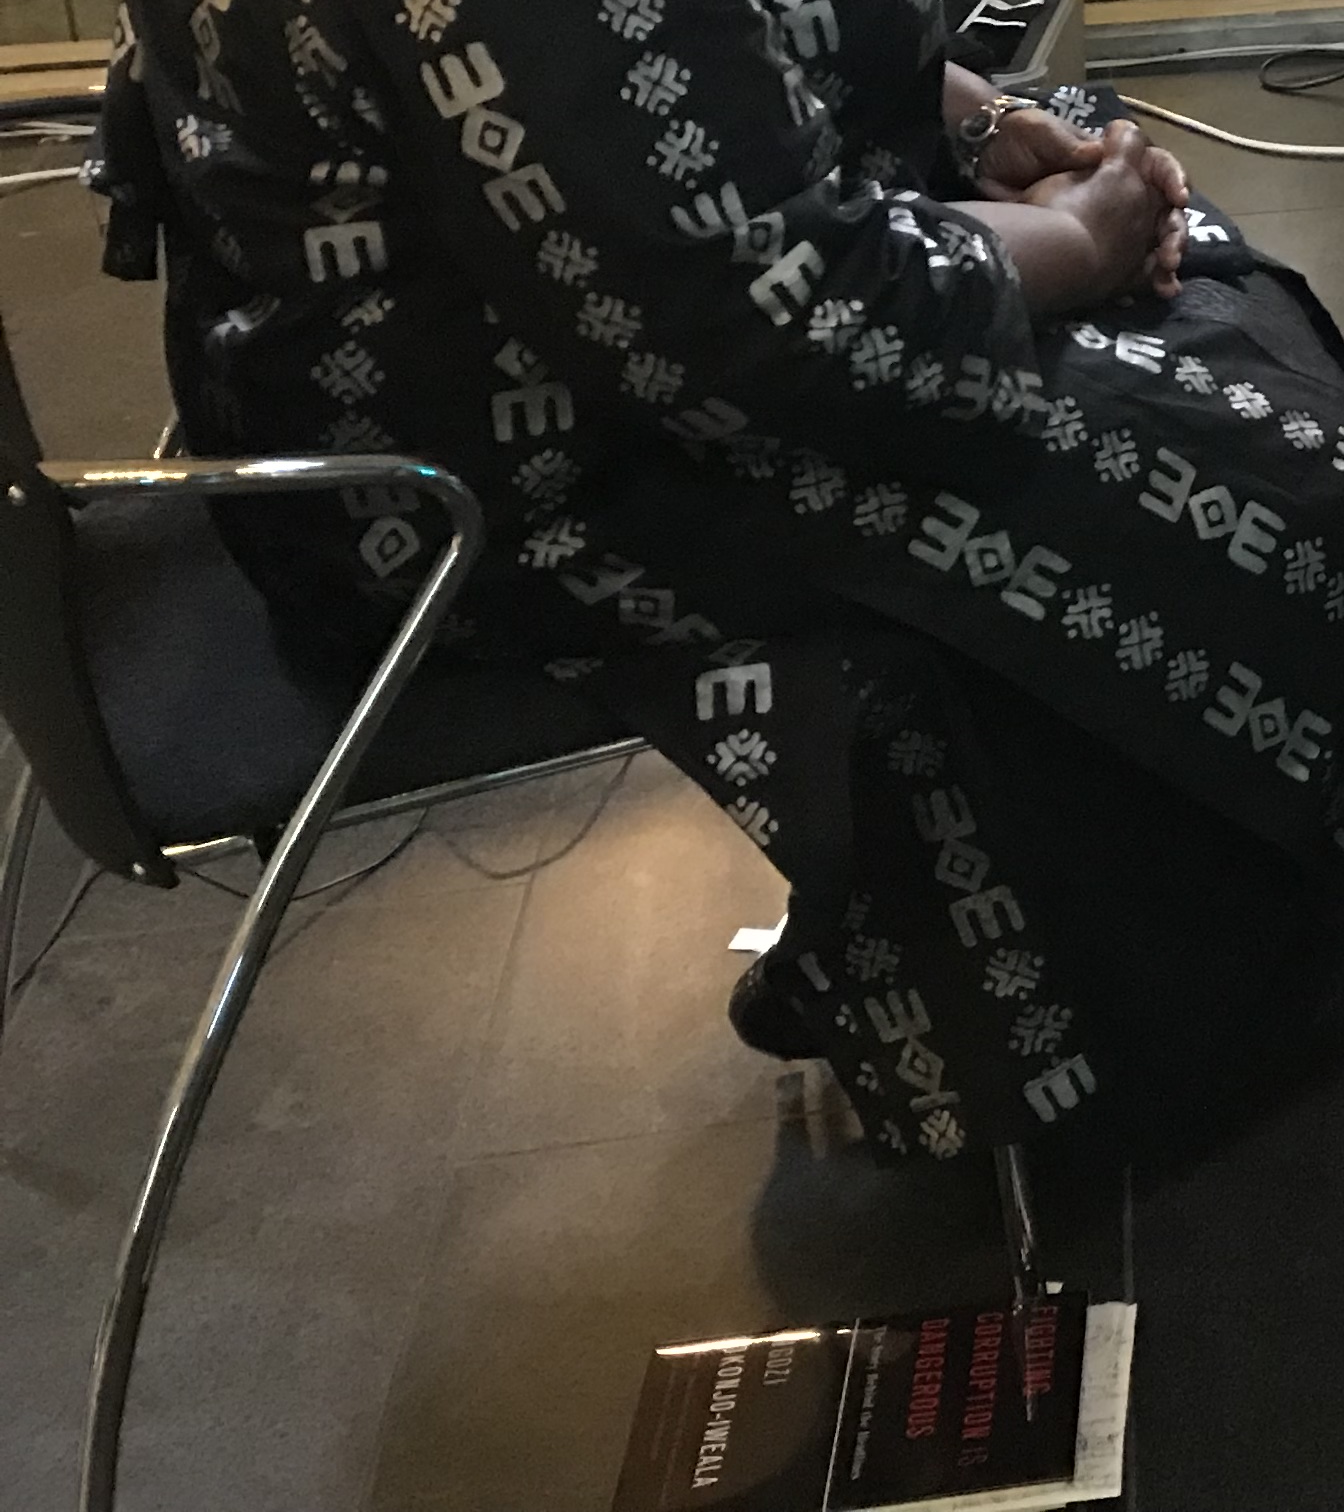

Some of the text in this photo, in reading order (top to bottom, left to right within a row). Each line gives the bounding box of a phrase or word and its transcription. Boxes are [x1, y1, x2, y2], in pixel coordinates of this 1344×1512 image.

[904, 1317, 951, 1440] DANGEROUS
[957, 1311, 1005, 1468] CORRUPTION IS
[1022, 1304, 1060, 1397] FIGHTING
